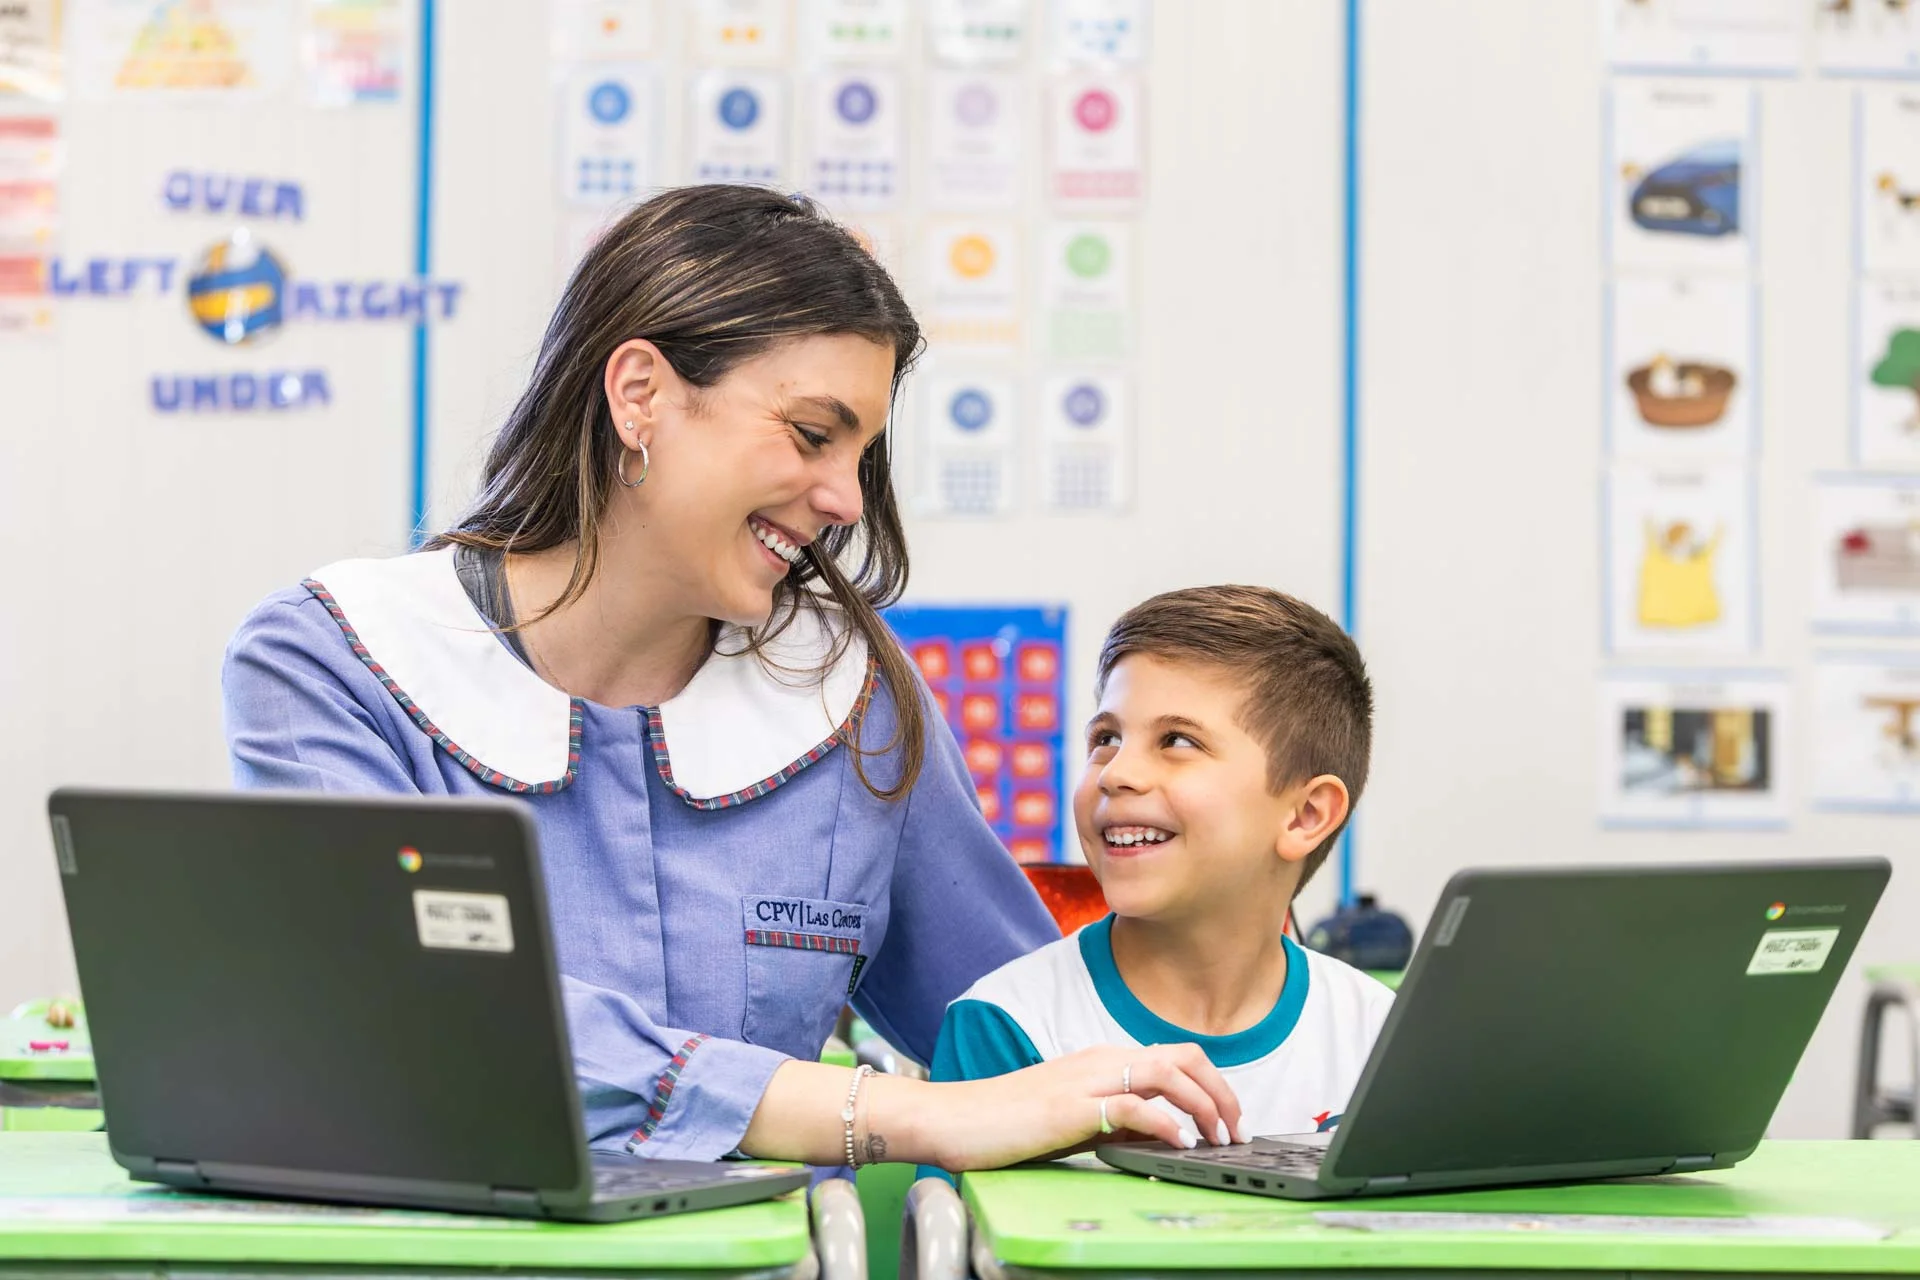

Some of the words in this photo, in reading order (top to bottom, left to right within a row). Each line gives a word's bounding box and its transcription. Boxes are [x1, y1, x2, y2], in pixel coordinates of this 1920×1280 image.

[164, 172, 305, 220] OVER
[49, 257, 177, 295] LEFT
[288, 281, 463, 319] RIGHT
[151, 369, 332, 412] UNDER
[756, 900, 797, 923] CPV
